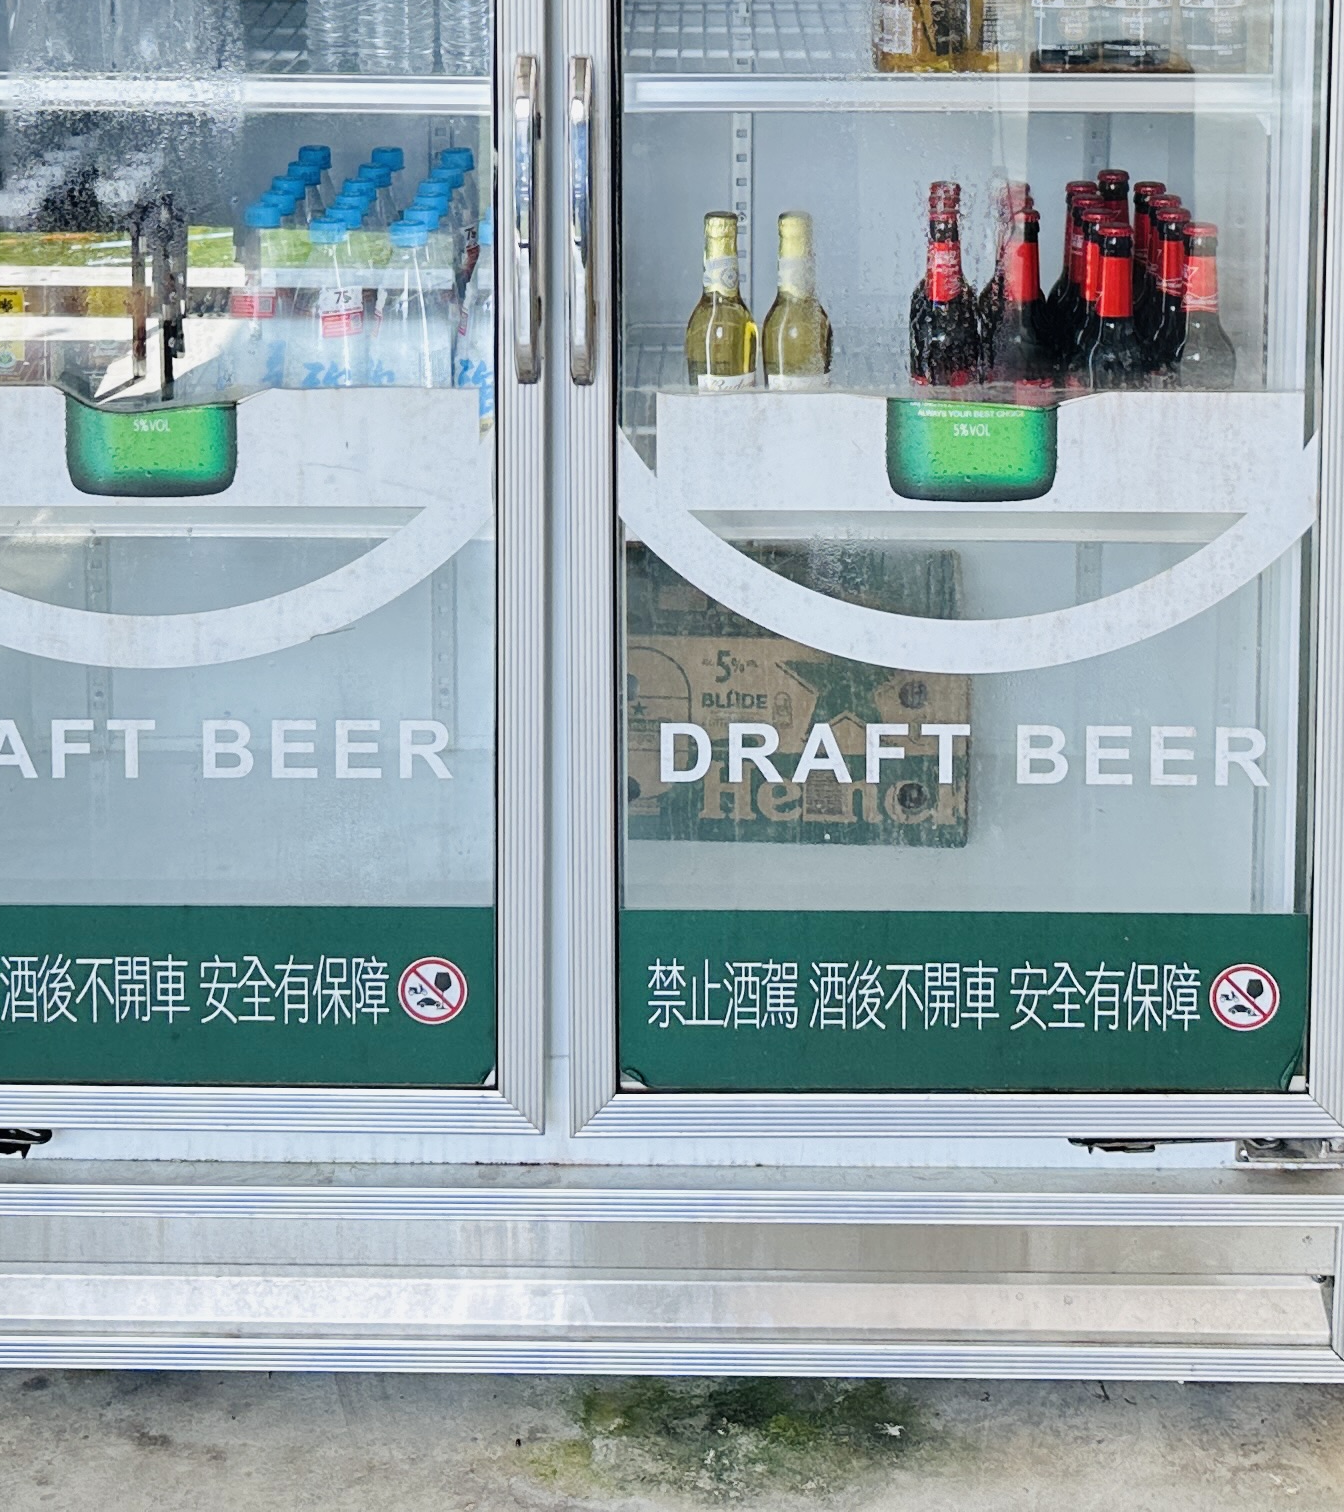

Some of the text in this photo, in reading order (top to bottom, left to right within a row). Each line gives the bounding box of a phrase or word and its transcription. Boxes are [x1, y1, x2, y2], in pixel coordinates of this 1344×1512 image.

[202, 719, 454, 780] BEER
[659, 722, 1270, 787] DRAFT BEER
[0, 952, 191, 1024] 酒後不開車
[199, 953, 391, 1025] 安全有保障
[646, 957, 1202, 1032] 禁止酒駕 酒後不開車 安全有保障
